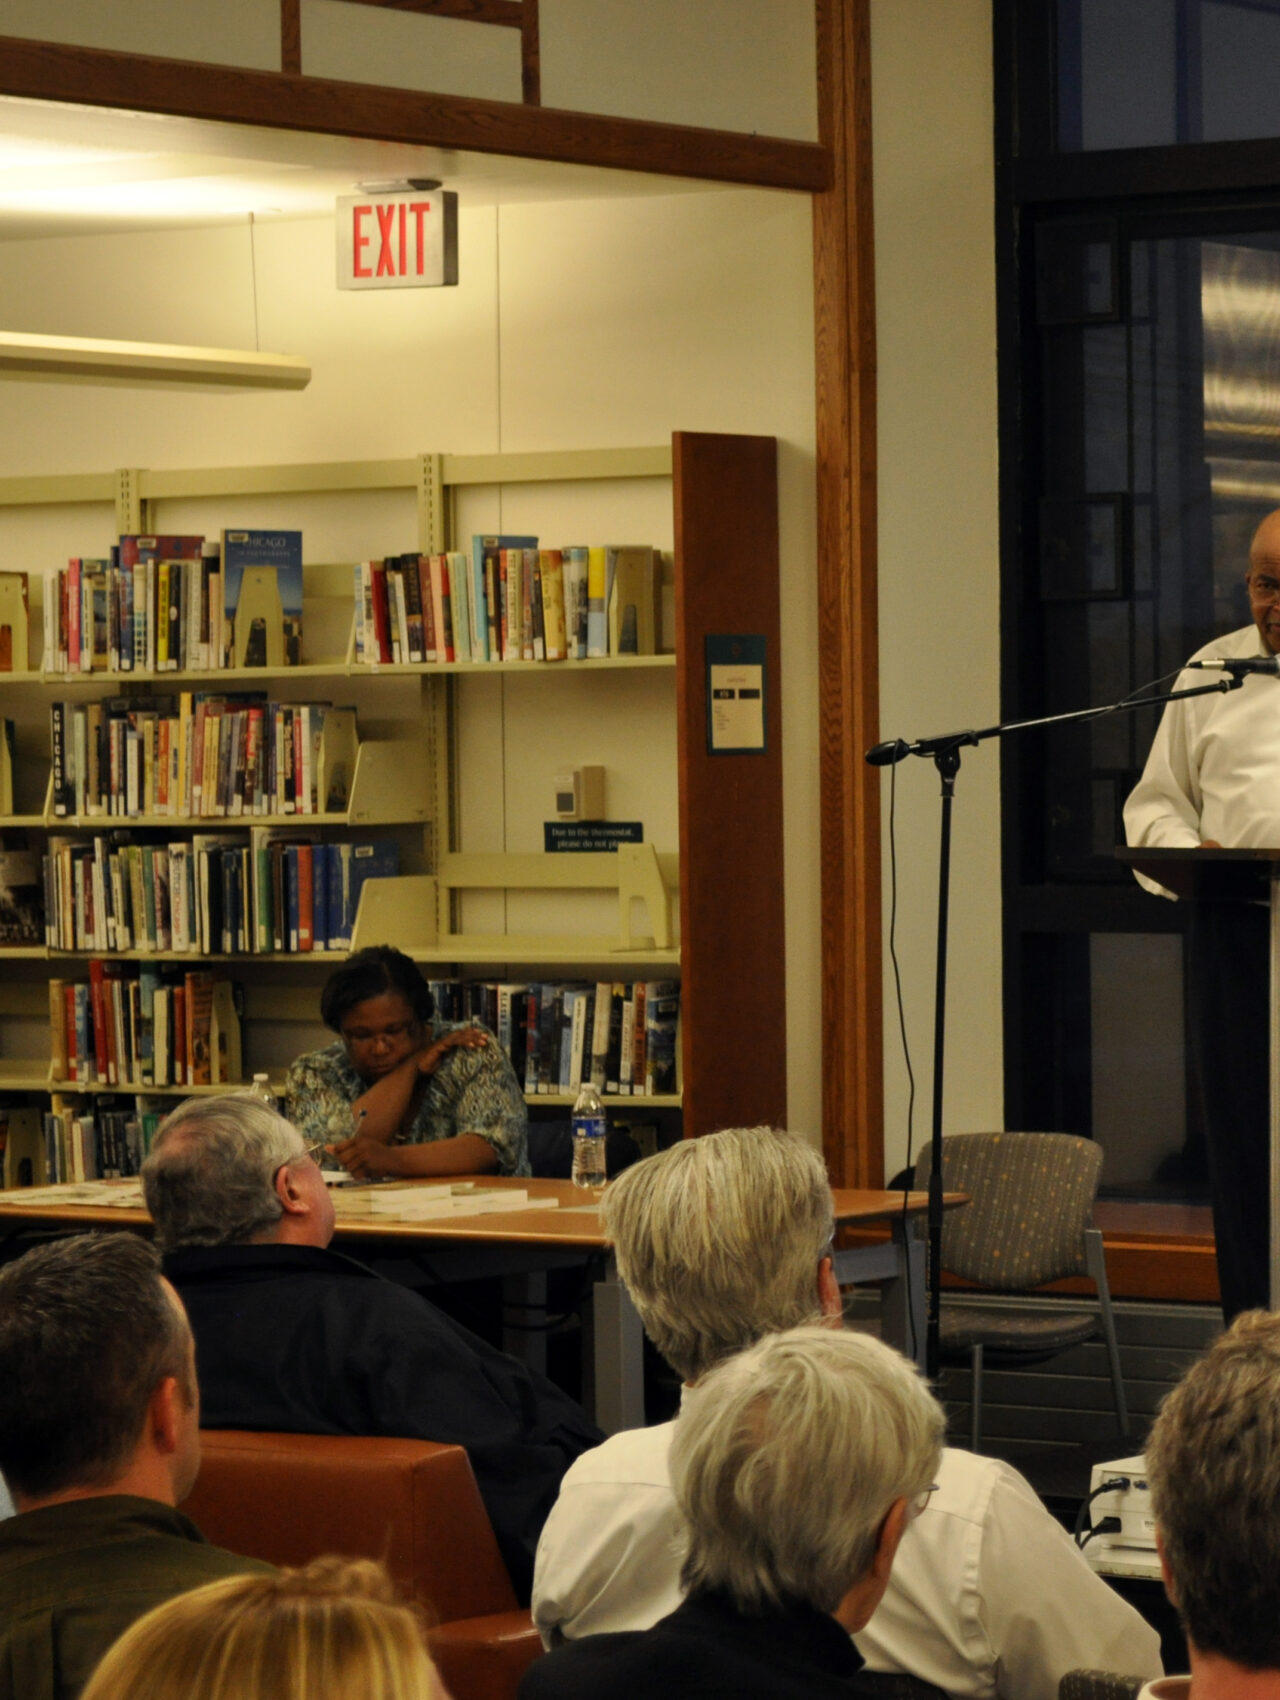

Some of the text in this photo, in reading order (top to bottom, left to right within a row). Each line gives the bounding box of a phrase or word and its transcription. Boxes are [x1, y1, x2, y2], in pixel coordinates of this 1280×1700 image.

[353, 201, 431, 279] EXIT
[53, 710, 62, 790] CHICAGO
[582, 840, 593, 848] do
[594, 840, 607, 848] not
